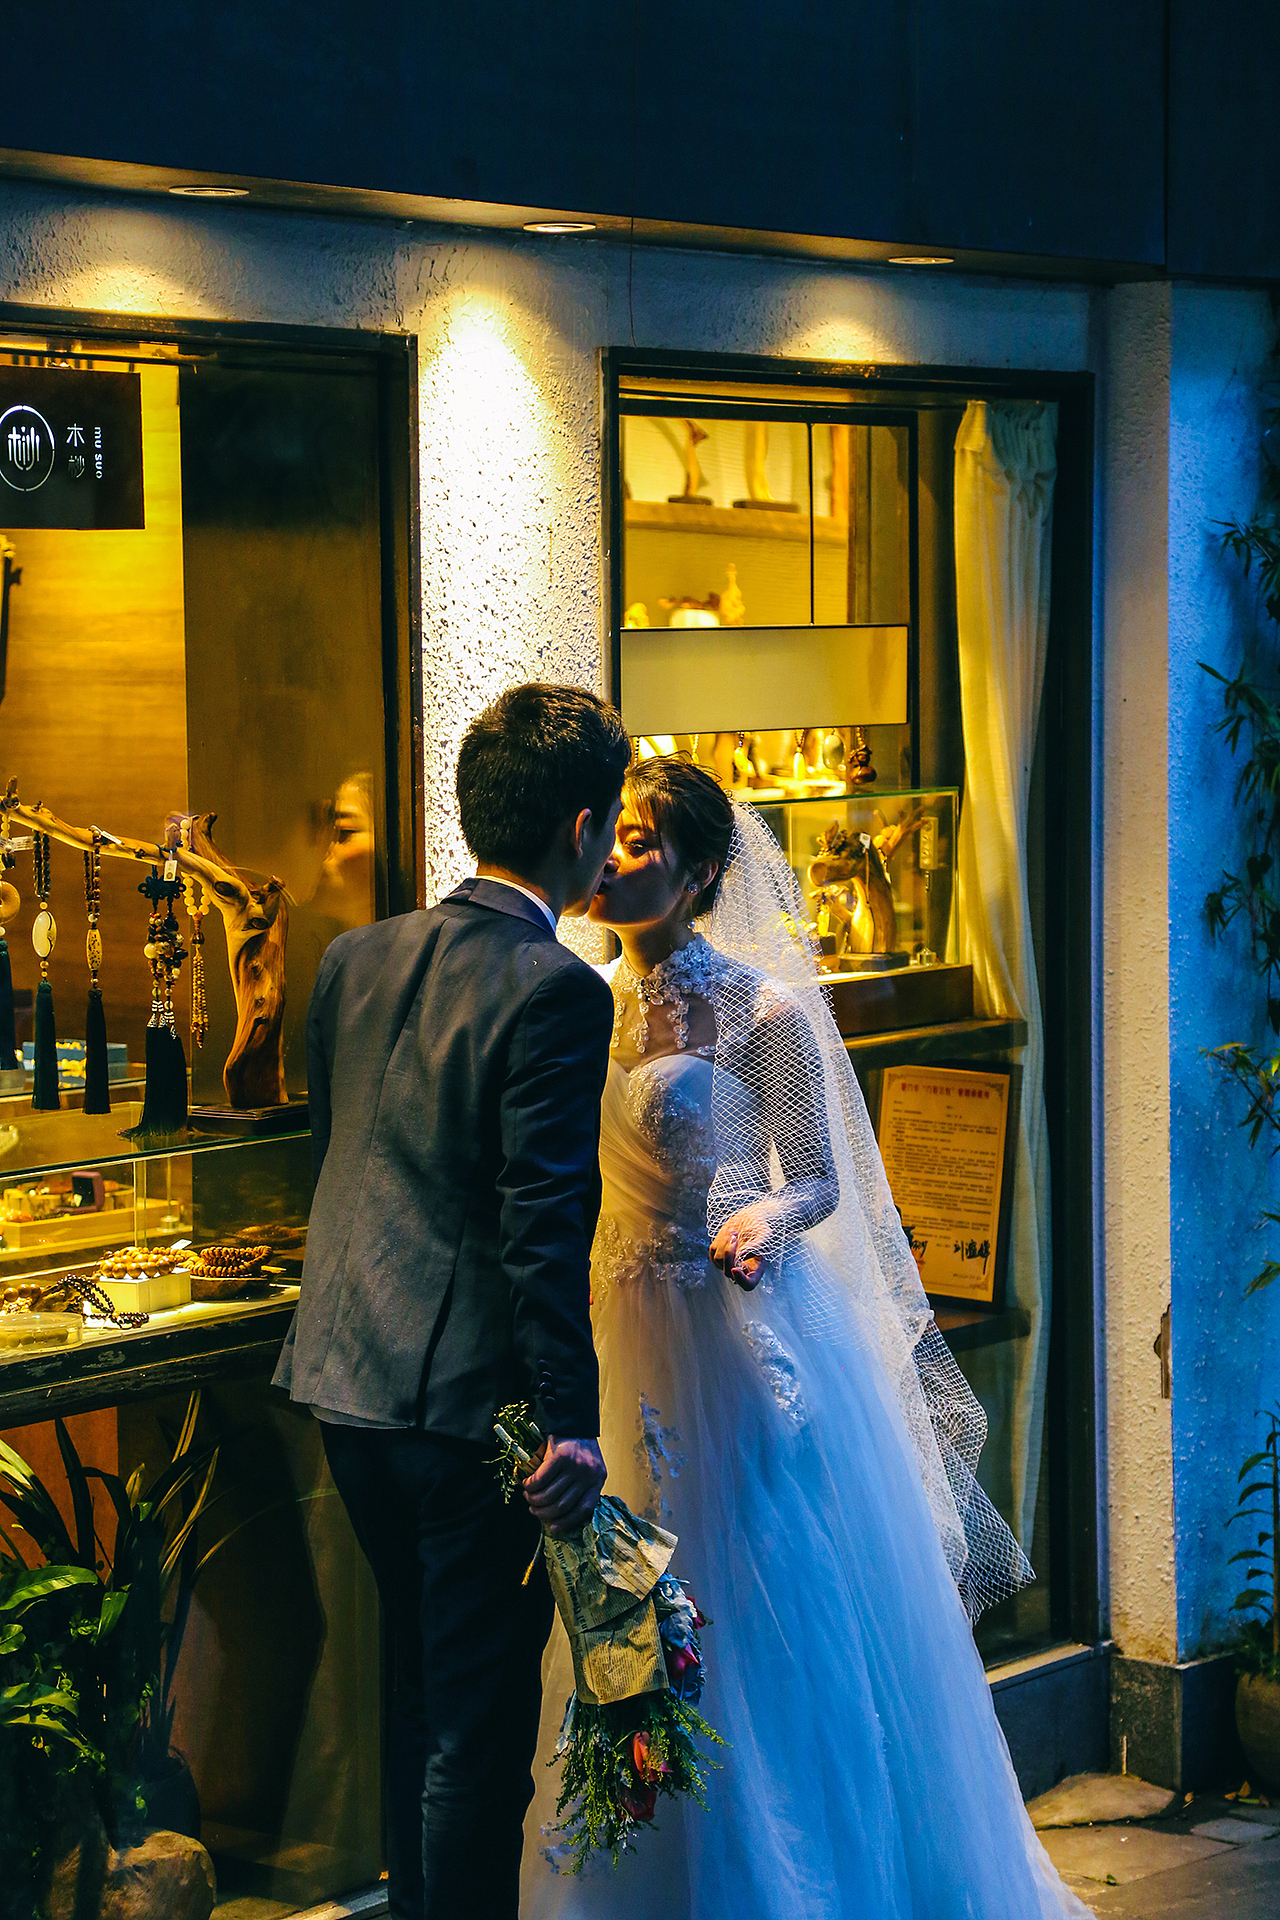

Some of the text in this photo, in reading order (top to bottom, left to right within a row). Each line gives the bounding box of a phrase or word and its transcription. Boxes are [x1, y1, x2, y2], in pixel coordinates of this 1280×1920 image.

[94, 426, 103, 479] mu suo
[564, 1570, 581, 1614] Graphing
